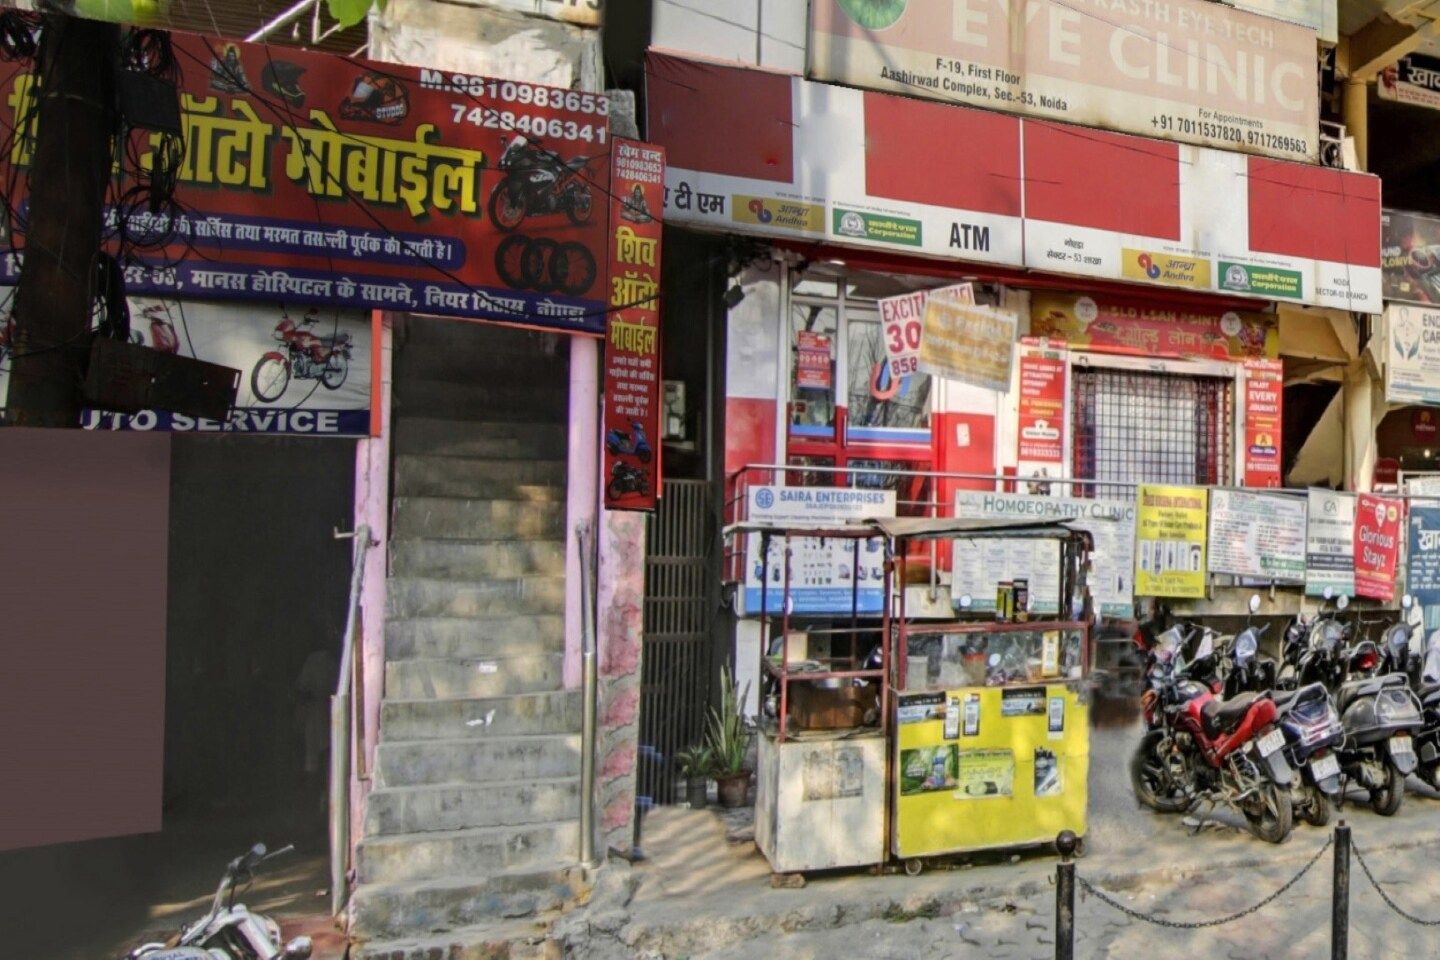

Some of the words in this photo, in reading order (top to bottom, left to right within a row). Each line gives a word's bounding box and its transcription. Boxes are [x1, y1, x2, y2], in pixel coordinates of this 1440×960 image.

[936, 57, 965, 76] F-19,
[967, 64, 992, 81] First
[995, 69, 1021, 86] Floor
[1110, 24, 1307, 112] CLINIC
[879, 65, 940, 89] Aashirwad
[942, 76, 991, 100] Complex,
[993, 86, 1038, 108] Sec.-53,
[1039, 96, 1068, 112] Noida
[451, 103, 607, 146] 7428406341
[1150, 114, 1173, 131] +91
[1198, 108, 1213, 119] For
[1213, 111, 1263, 129] Appointments
[674, 181, 692, 211] टी
[696, 192, 726, 215] एम
[776, 216, 808, 227] Andhra
[868, 228, 916, 241] Corporation
[615, 225, 658, 268] शिव
[949, 222, 991, 253] ATM
[190, 269, 246, 291] मानस
[336, 276, 356, 299] के
[1163, 271, 1195, 283] Andhra
[1251, 281, 1297, 292] Corporation
[611, 270, 659, 313] ऑटो
[886, 321, 923, 355] 30
[1248, 390, 1278, 402] EVERY
[780, 491, 812, 503] SAIRA
[815, 492, 886, 505] ENTERPRISES
[983, 495, 1087, 520] HOMOEOPATHY
[1090, 503, 1134, 520] CLINIC
[1360, 525, 1394, 549] Glorious
[1363, 545, 1386, 571] Stayz
